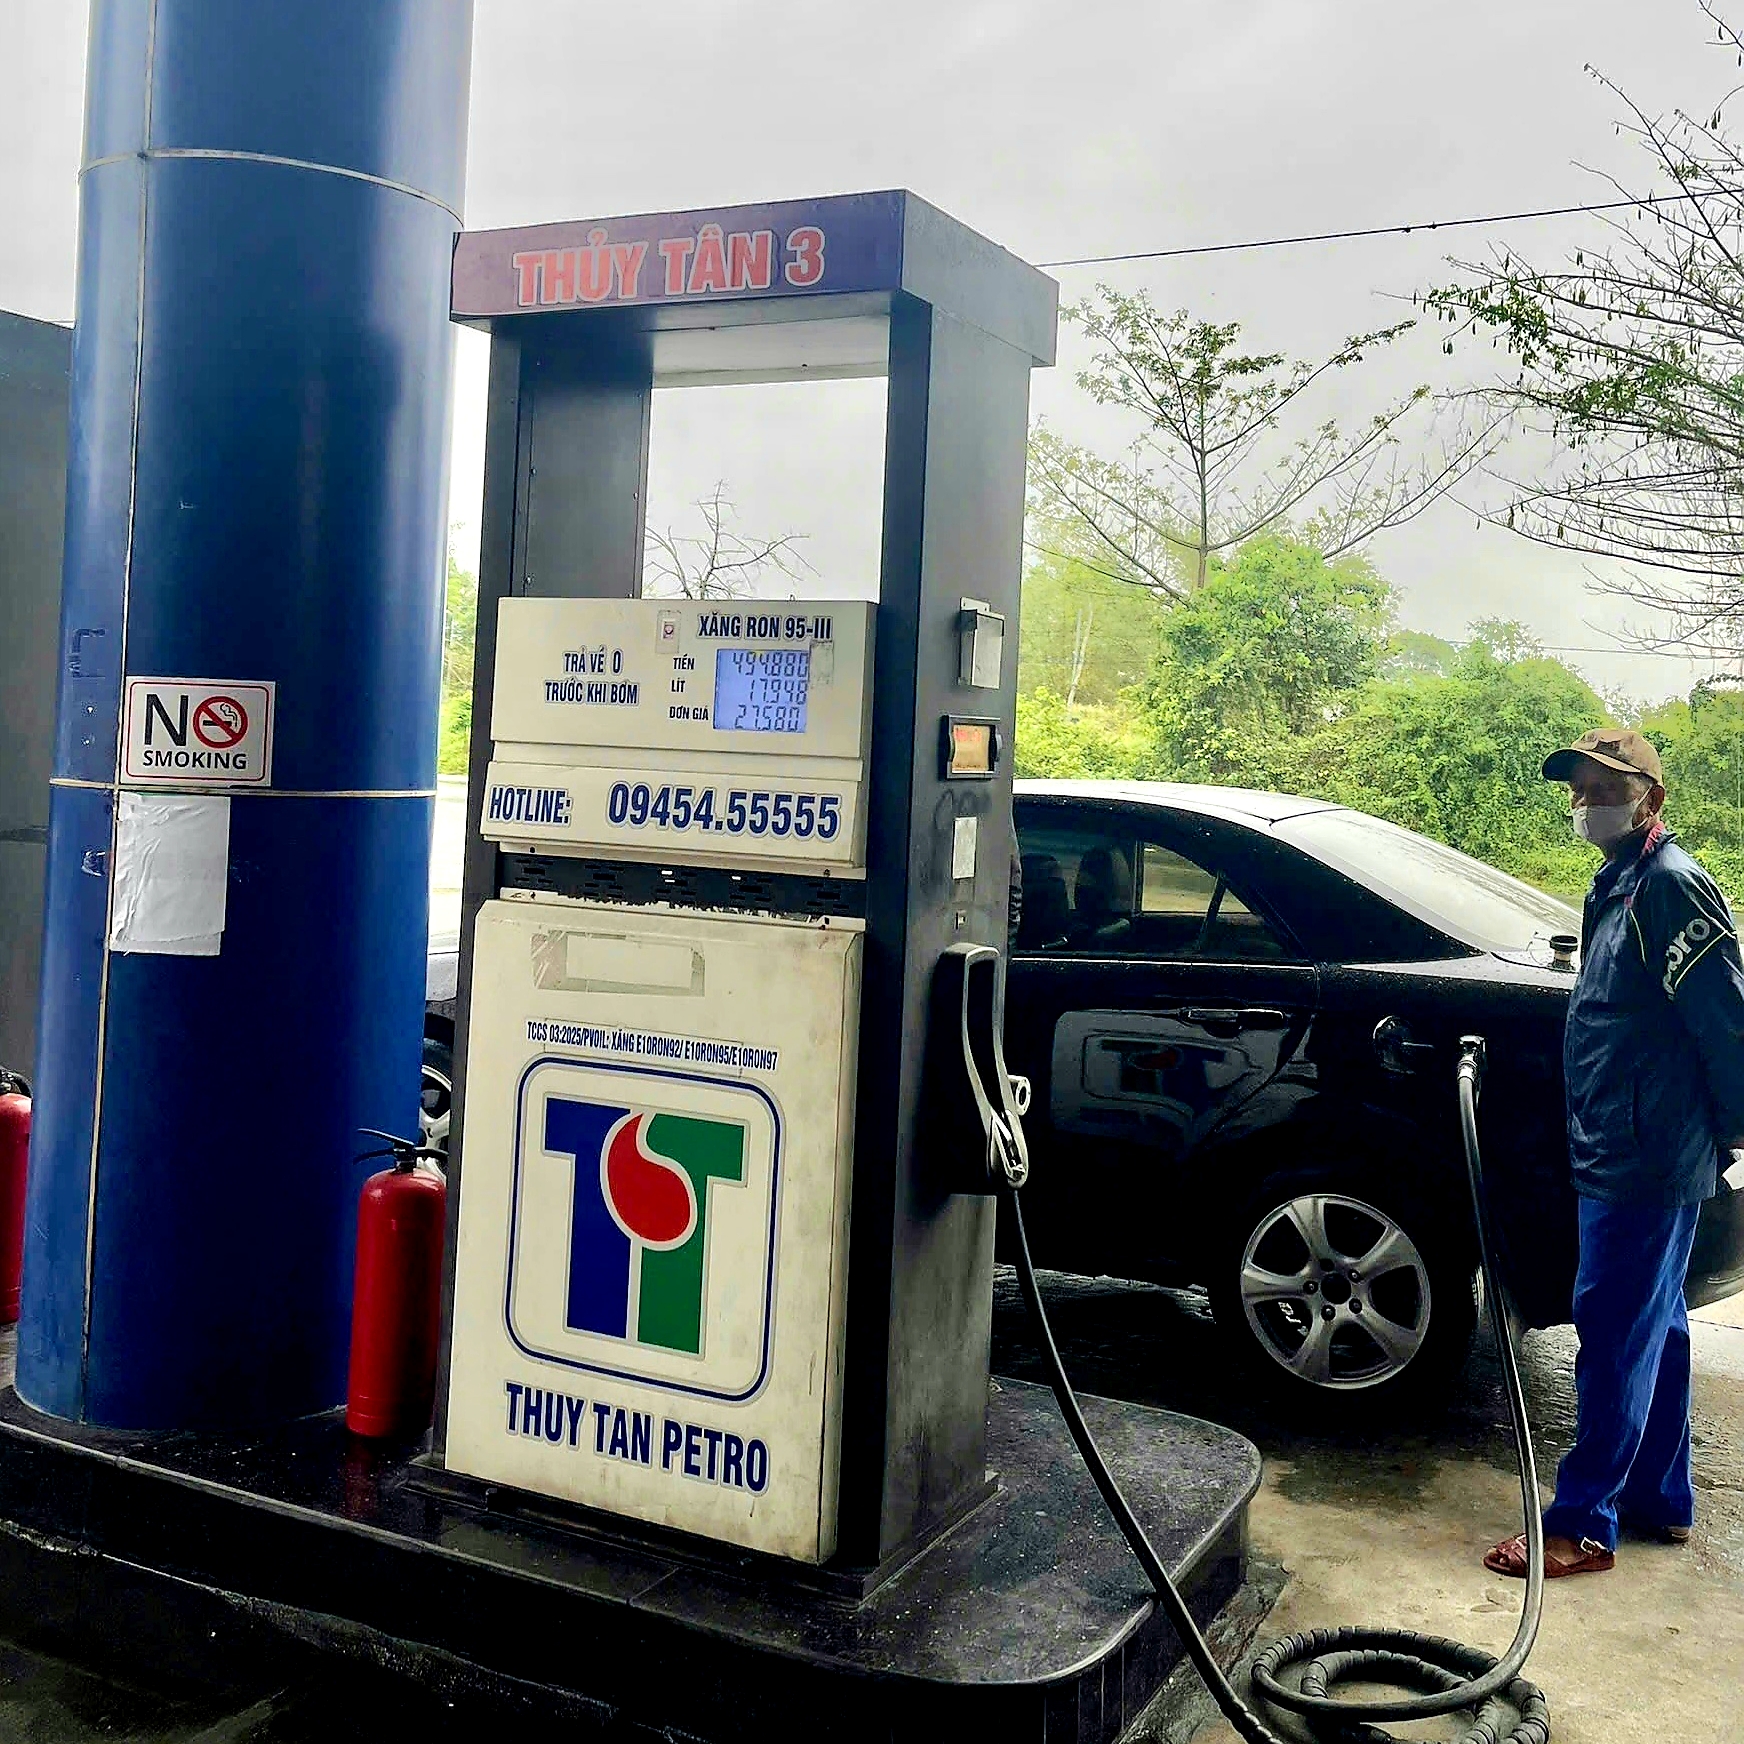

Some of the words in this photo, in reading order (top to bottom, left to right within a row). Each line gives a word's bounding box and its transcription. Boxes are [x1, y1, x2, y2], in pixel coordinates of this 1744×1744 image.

[514, 229, 647, 305] THỦY
[660, 223, 773, 294] TÂN
[786, 227, 824, 287] 3
[699, 612, 740, 637] XĂNG
[746, 616, 780, 638] RON
[785, 617, 831, 639] 95-III
[587, 683, 607, 703] KHI
[142, 750, 248, 770] SMOKING
[489, 787, 571, 824] HOTLINE:
[609, 783, 839, 838] 09454.55555
[527, 1021, 548, 1042] TCCS
[611, 1029, 635, 1052] XĂNG
[506, 1382, 585, 1446] THUY
[593, 1403, 651, 1464] TAN
[662, 1419, 767, 1492] PETRO
